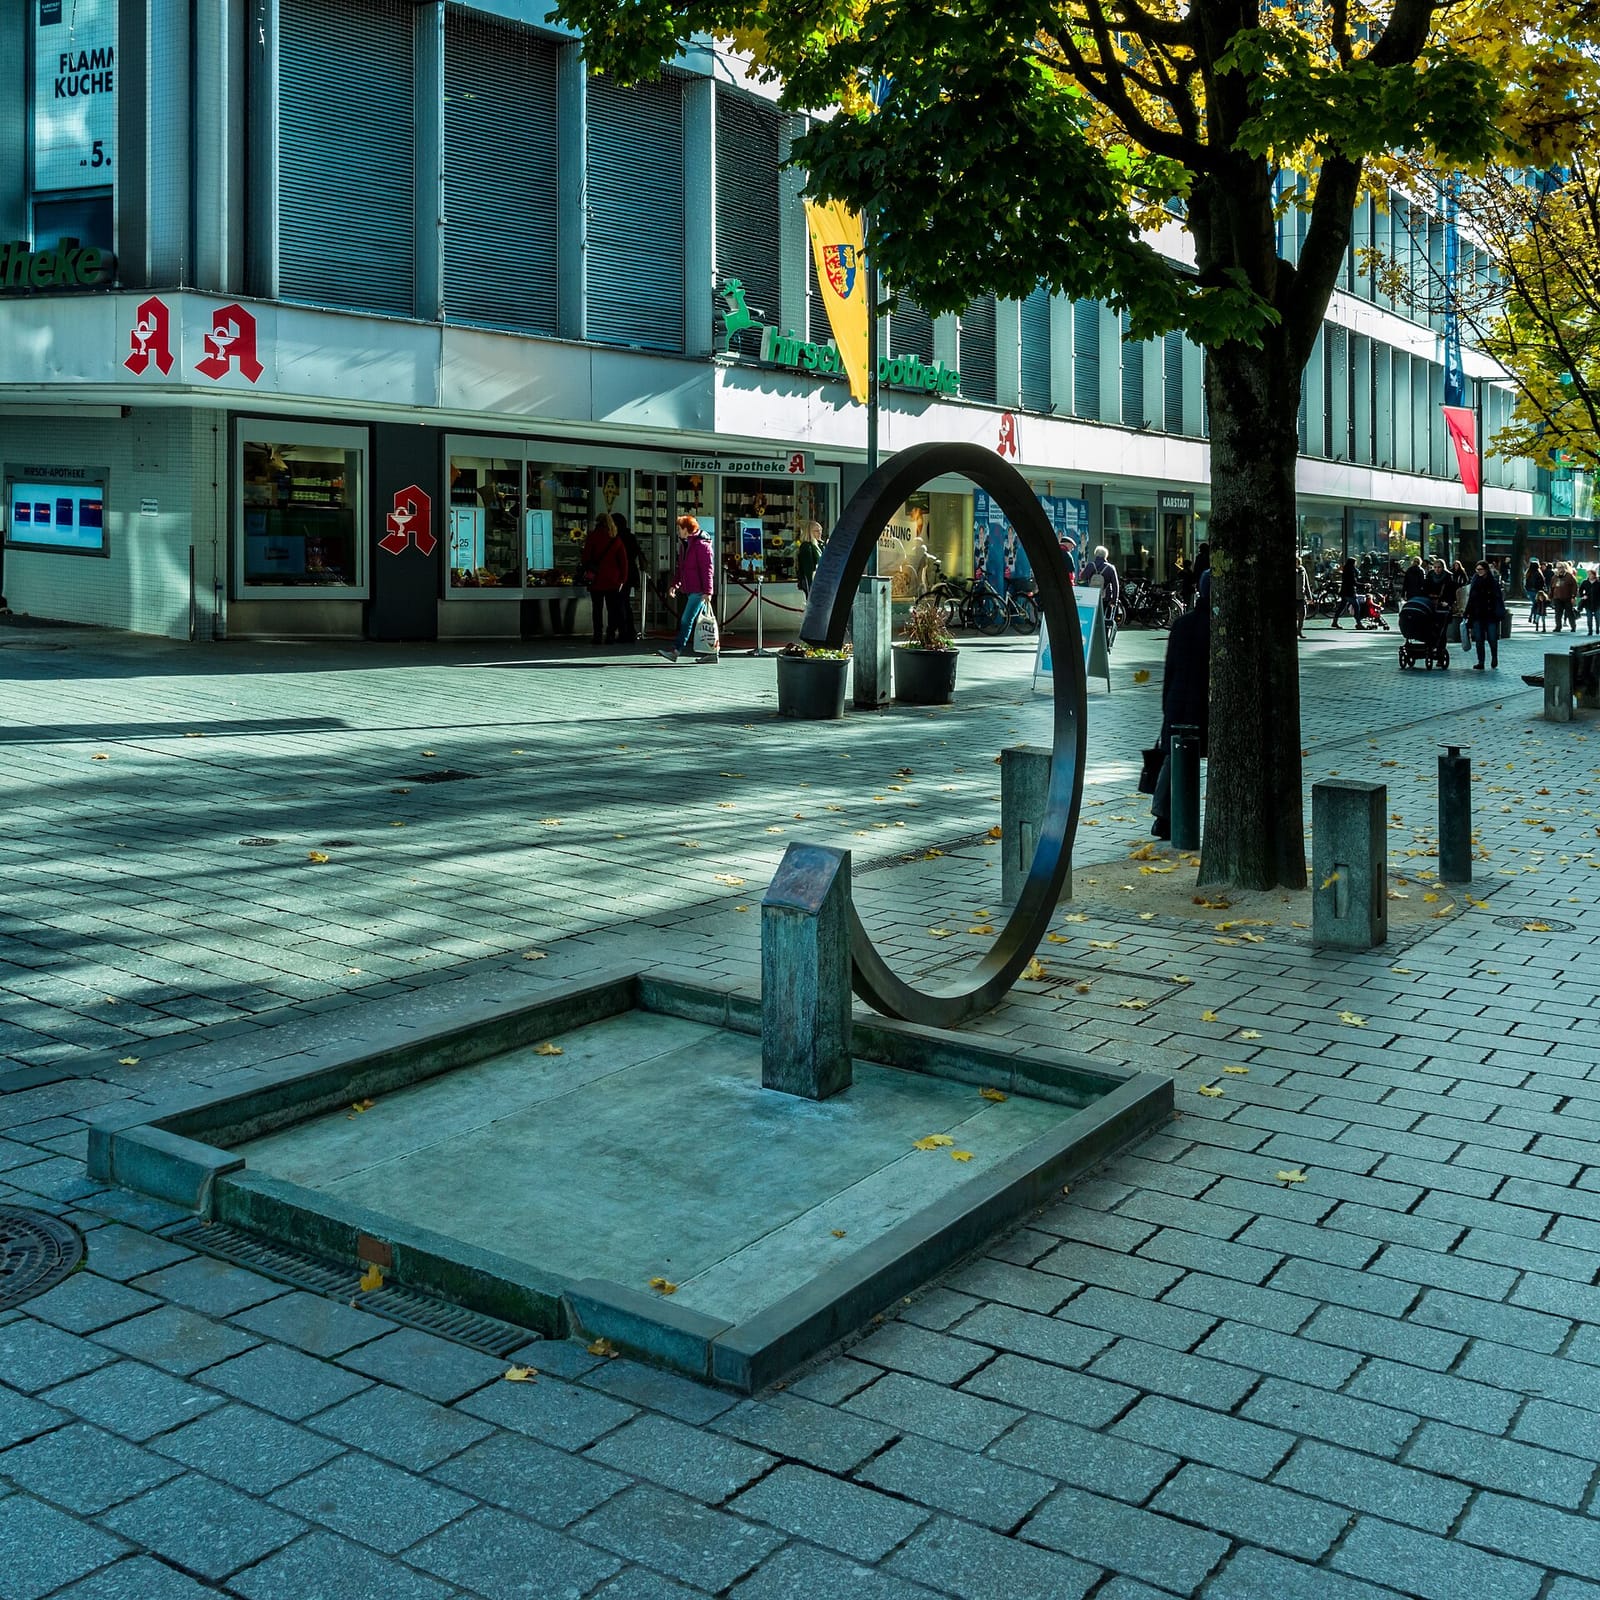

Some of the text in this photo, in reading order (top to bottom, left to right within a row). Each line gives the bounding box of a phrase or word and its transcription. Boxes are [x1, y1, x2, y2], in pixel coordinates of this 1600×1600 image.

[54, 70, 113, 98] KUCHE
[683, 459, 720, 470] hirsch
[728, 460, 786, 472] apotheke
[1162, 496, 1190, 509] KARSTADT
